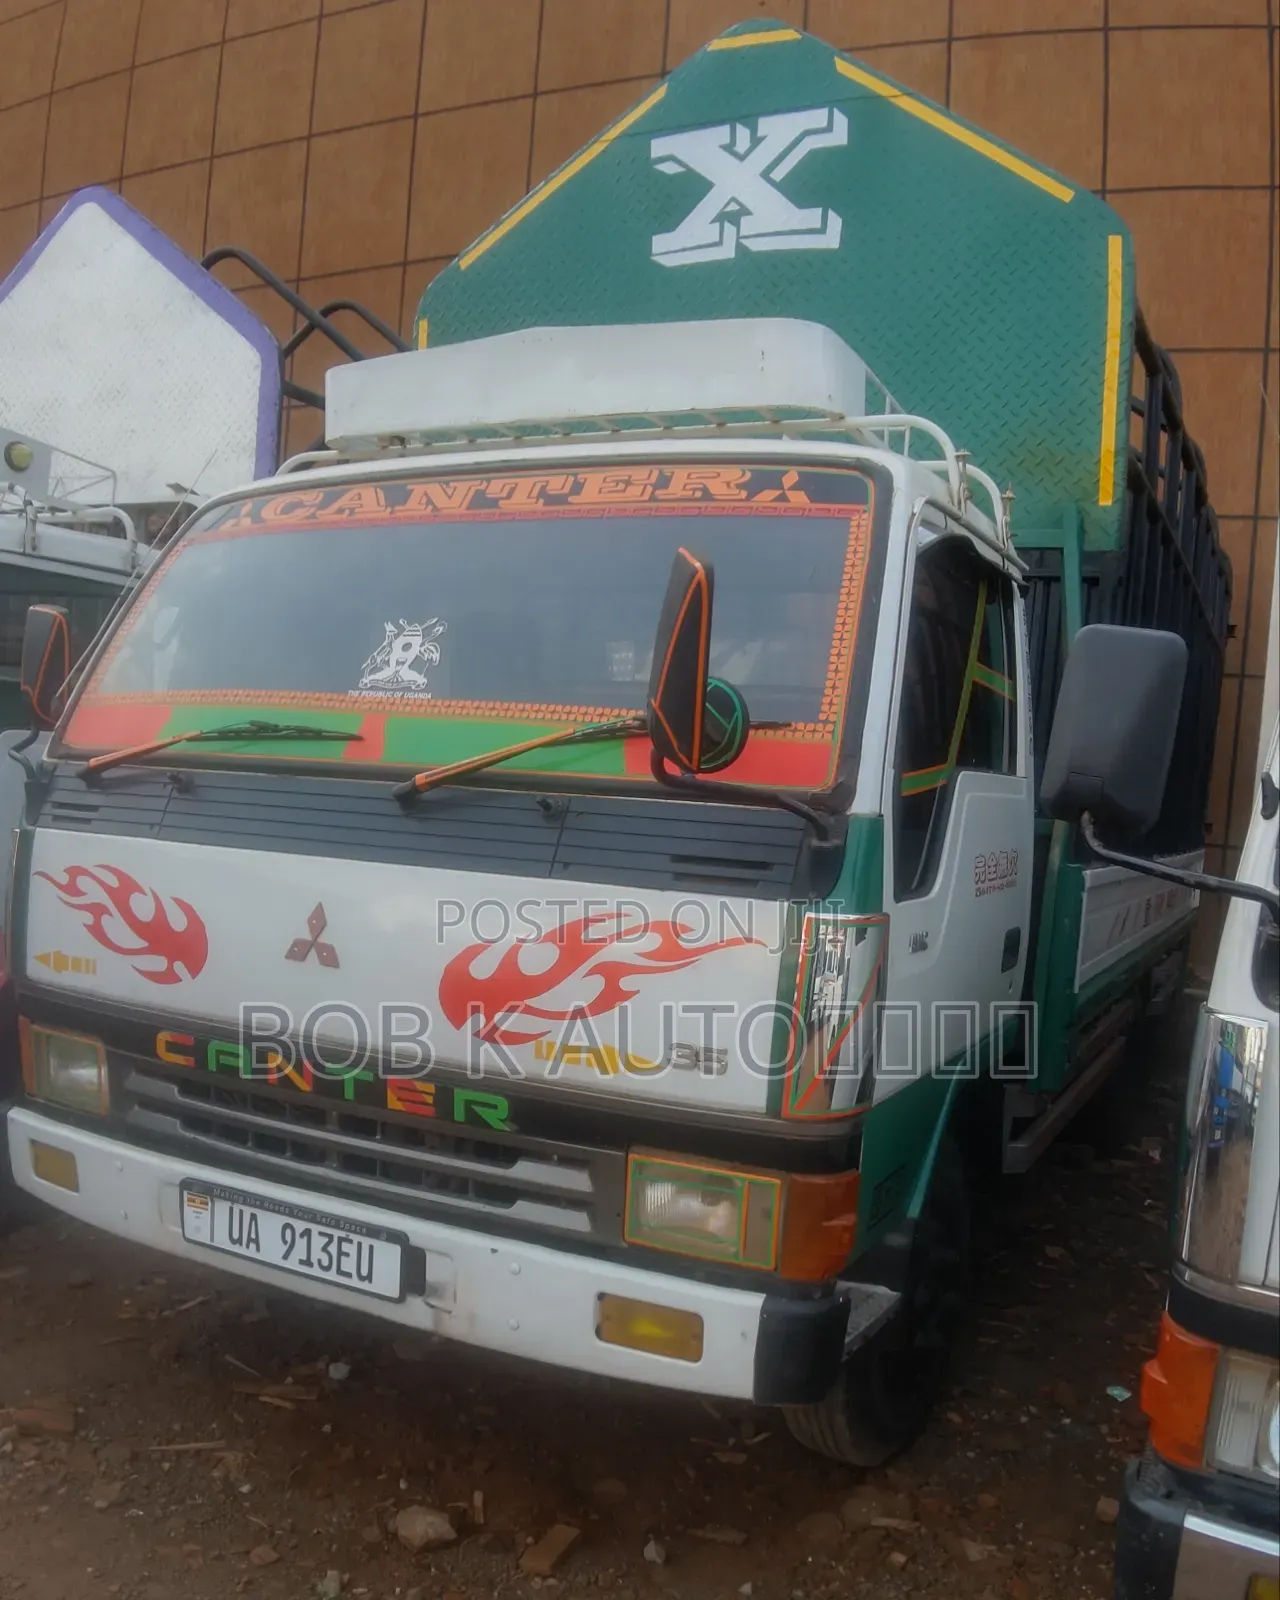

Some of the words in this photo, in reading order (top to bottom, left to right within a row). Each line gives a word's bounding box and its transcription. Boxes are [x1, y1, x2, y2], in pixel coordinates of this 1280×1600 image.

[650, 107, 848, 267] X
[260, 467, 755, 524] CANTER
[155, 1030, 516, 1132] CANTER
[668, 1040, 728, 1076] 35
[213, 1188, 244, 1204] Making
[247, 1196, 261, 1206] the
[263, 1201, 290, 1214] Roads
[293, 1208, 313, 1219] Your
[340, 1220, 367, 1233] Space
[228, 1204, 261, 1253] UA
[280, 1222, 374, 1284] 913EU
